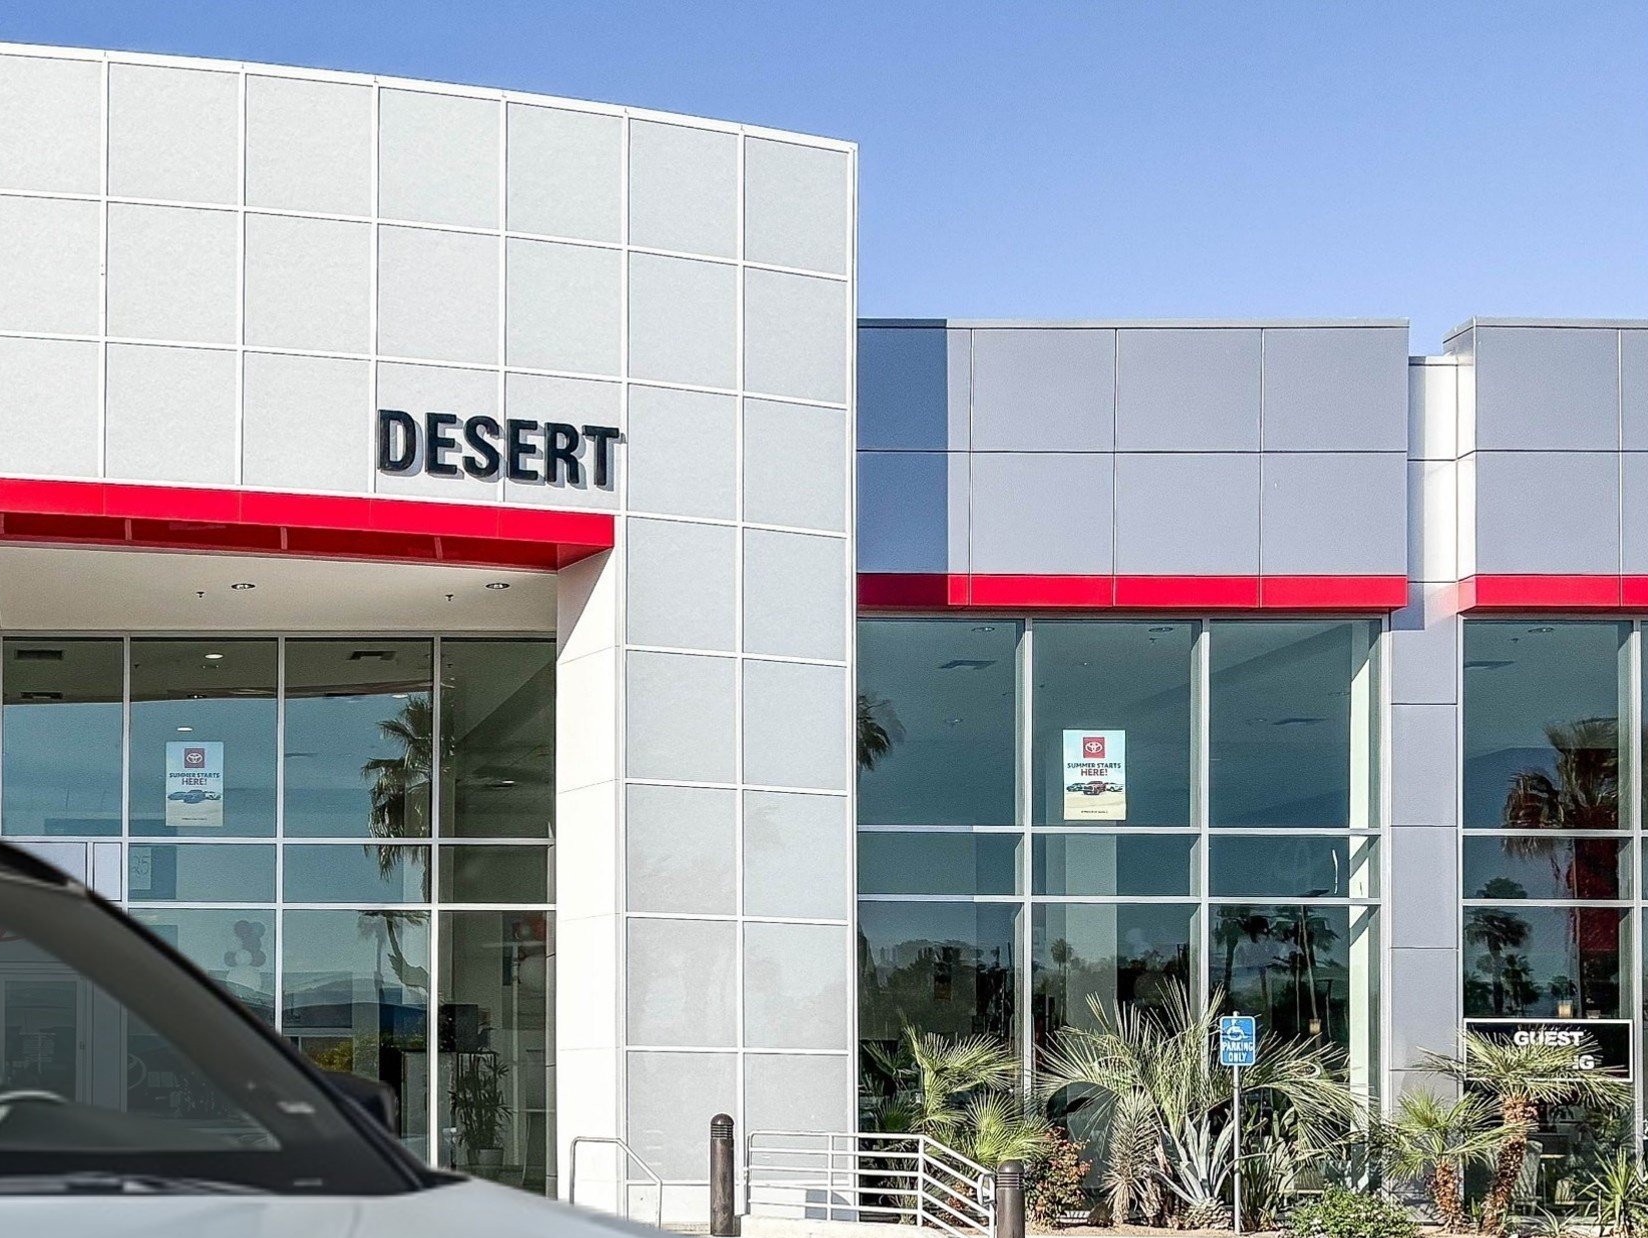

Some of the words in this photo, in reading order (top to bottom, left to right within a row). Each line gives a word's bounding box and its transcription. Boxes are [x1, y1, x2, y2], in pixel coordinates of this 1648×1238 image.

[377, 409, 620, 487] DESERT
[181, 778, 208, 786] HERE!
[1513, 1031, 1584, 1046] GUEST
[1222, 1041, 1254, 1052] PARKING
[1228, 1052, 1248, 1062] ONLY
